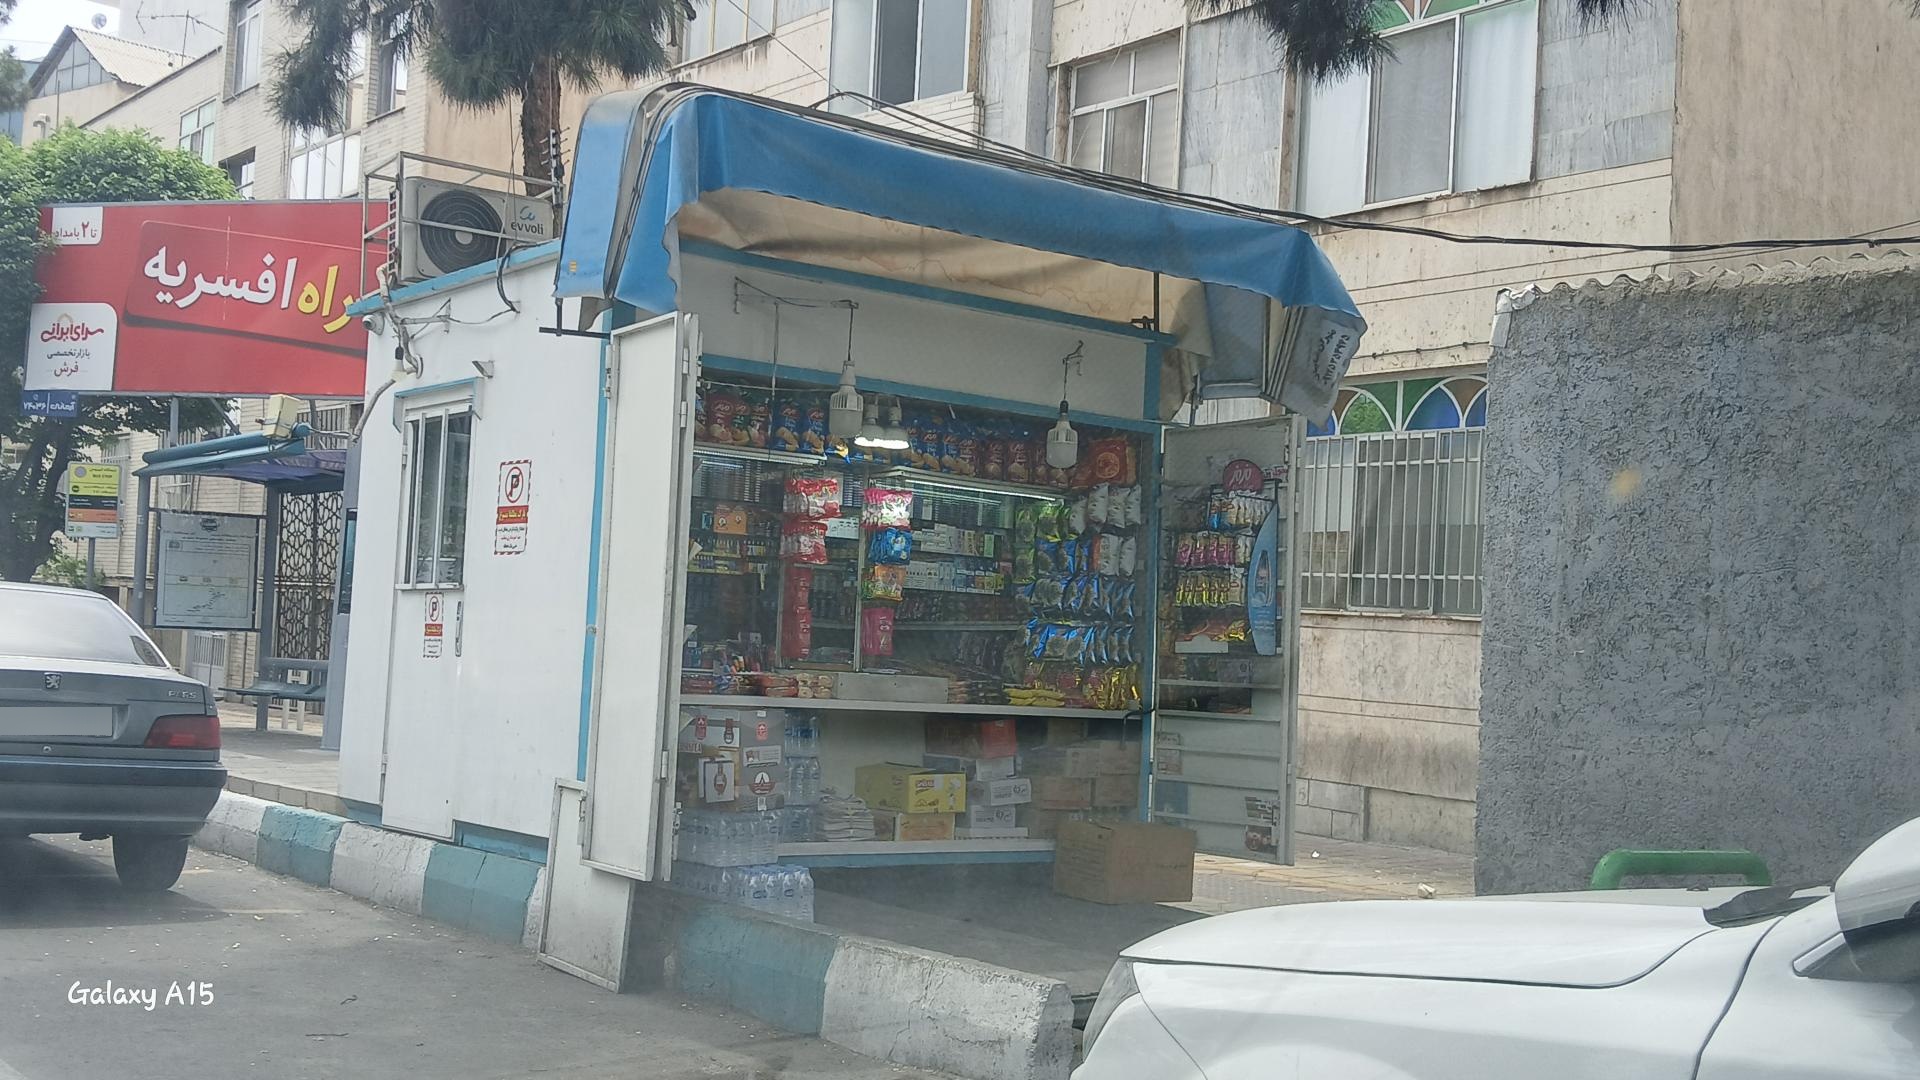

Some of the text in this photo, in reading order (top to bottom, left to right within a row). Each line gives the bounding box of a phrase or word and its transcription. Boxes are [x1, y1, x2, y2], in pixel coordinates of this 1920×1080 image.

[55, 220, 98, 240] تا ۲ بامداد
[510, 221, 544, 235] evvoli
[143, 245, 298, 310] افسریه
[54, 360, 79, 377] فرش
